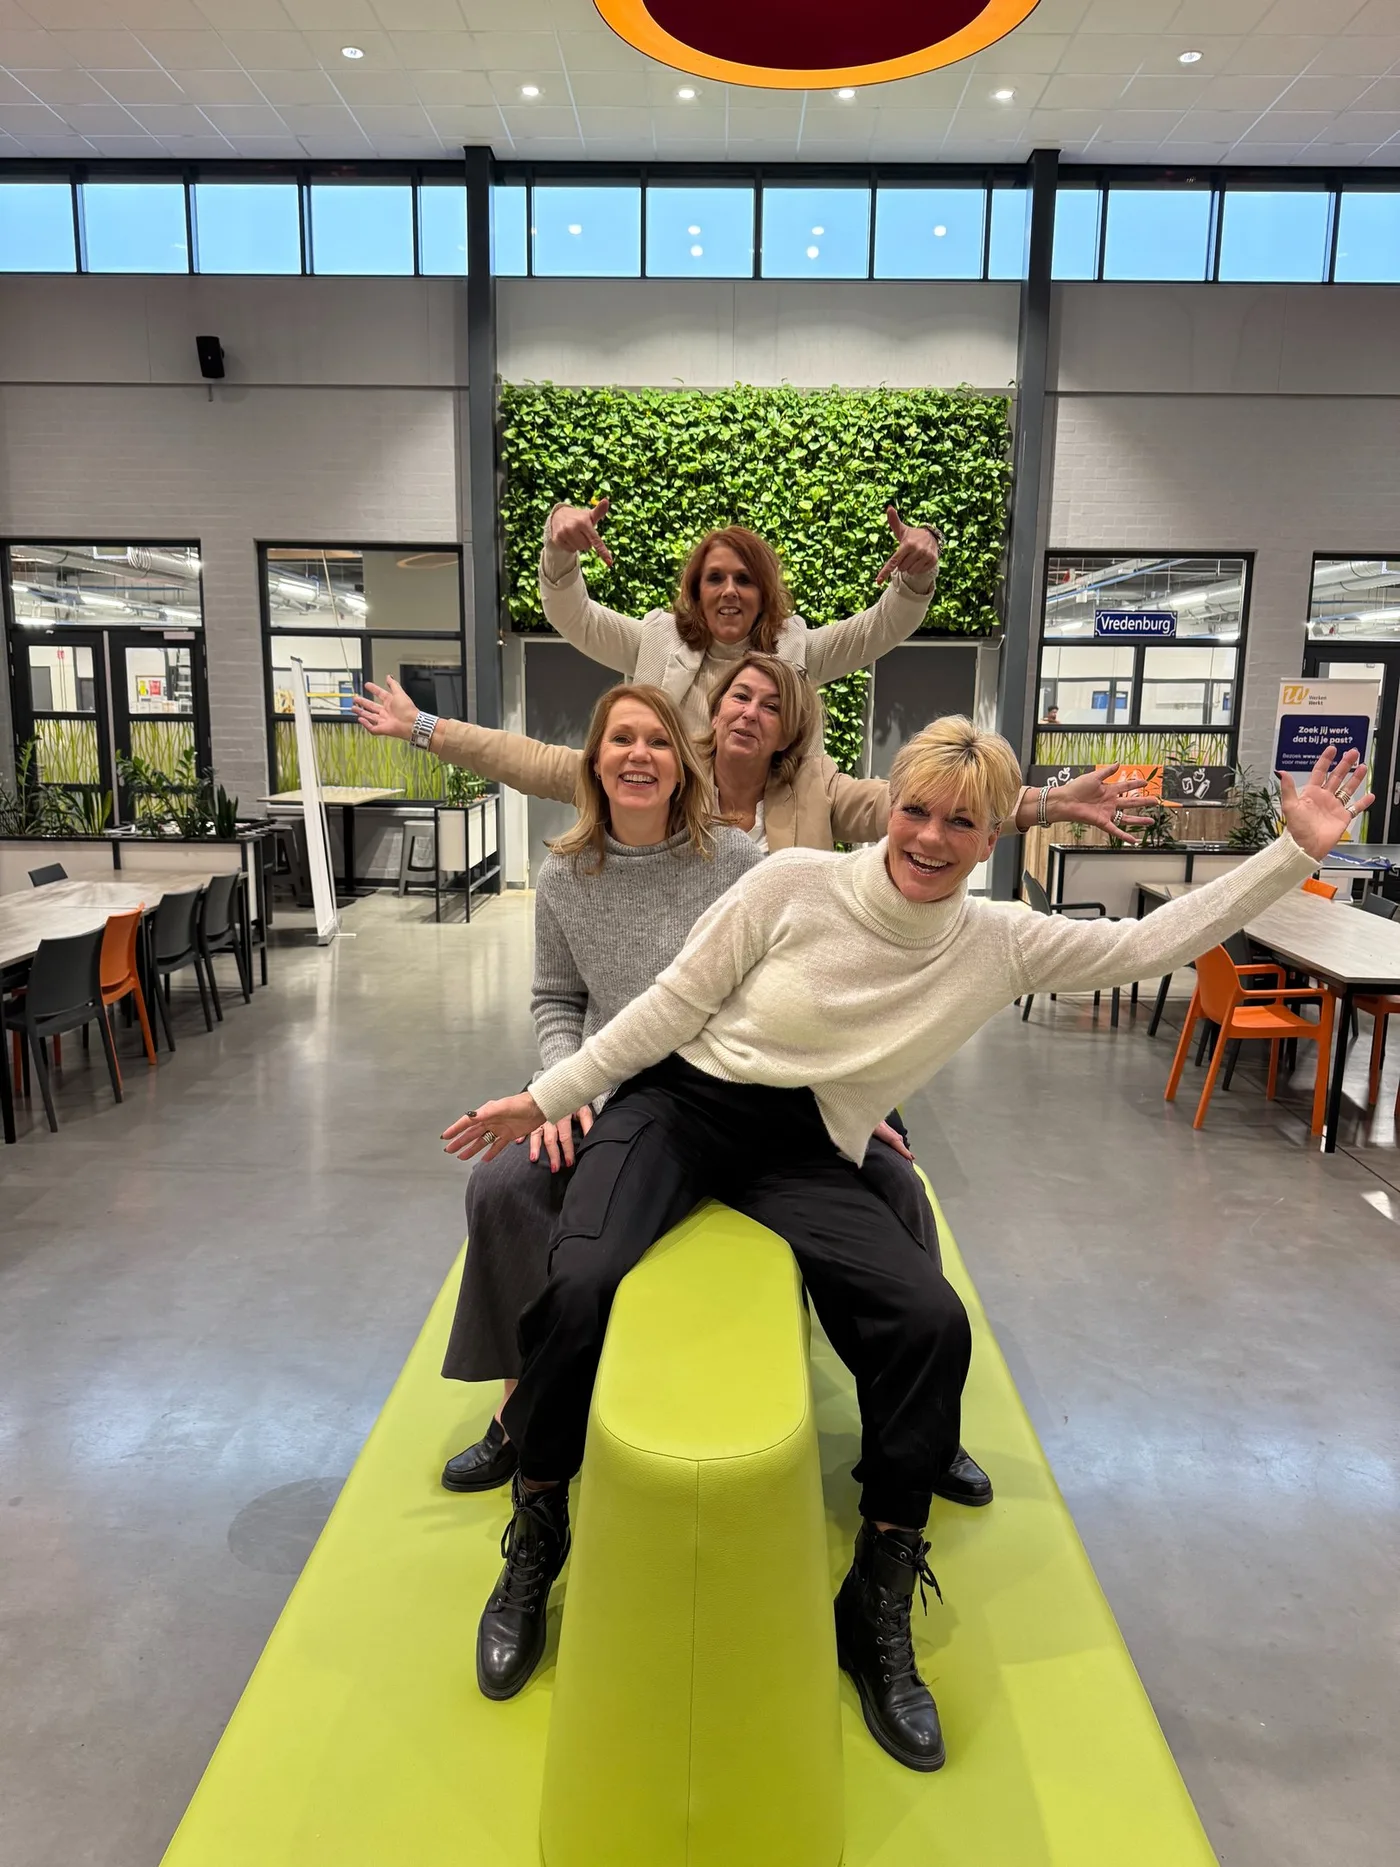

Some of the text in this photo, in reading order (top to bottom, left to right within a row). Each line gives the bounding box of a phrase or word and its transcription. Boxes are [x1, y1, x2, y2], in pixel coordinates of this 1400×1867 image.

[1101, 616, 1171, 634] Vredenburg
[1320, 726, 1328, 735] jij
[1309, 736, 1319, 744] bij
[1320, 736, 1328, 744] je
[1330, 737, 1353, 745] past?
